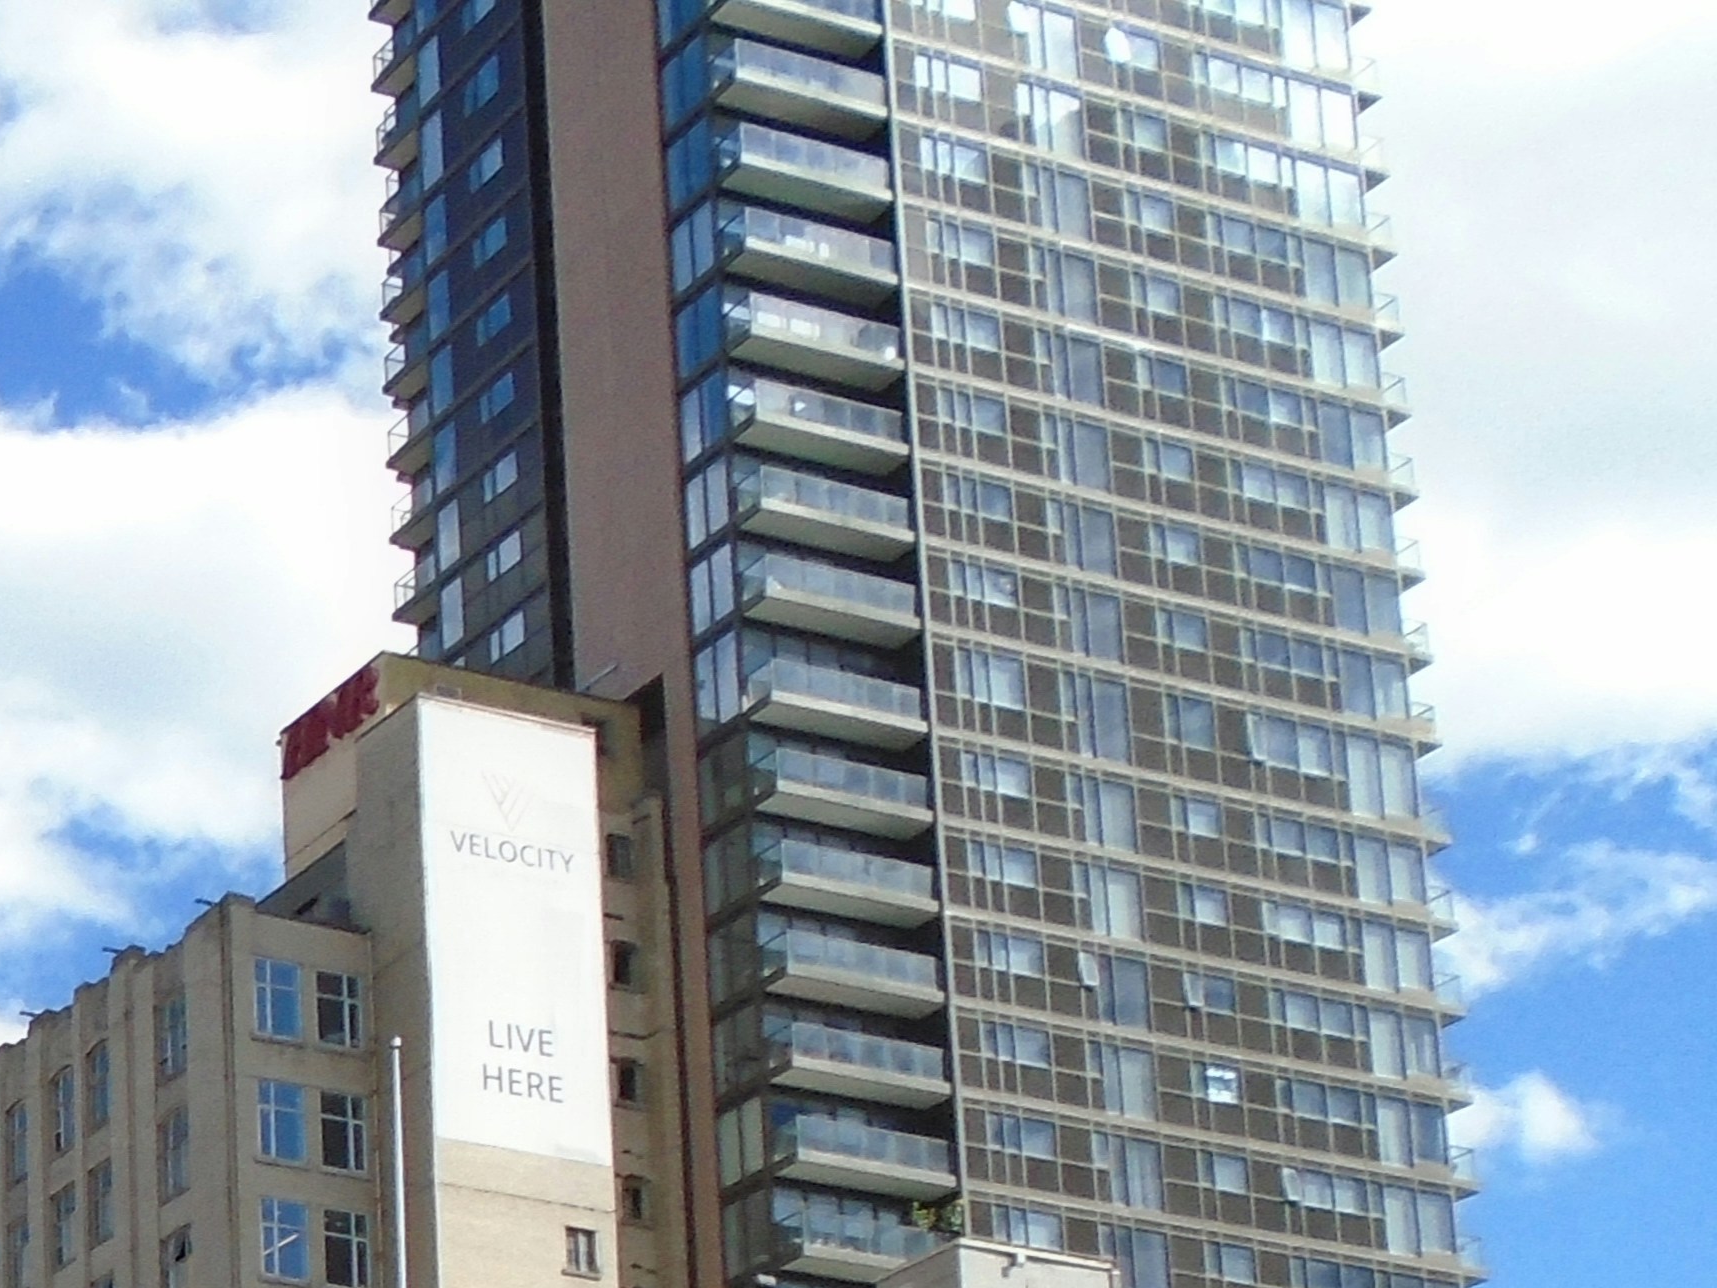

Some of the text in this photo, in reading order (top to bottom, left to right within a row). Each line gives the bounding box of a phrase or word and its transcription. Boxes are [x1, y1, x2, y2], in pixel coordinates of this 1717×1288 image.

[450, 831, 575, 873] VELOCITY
[488, 1019, 554, 1057] LIVE
[483, 1064, 564, 1104] HERE
